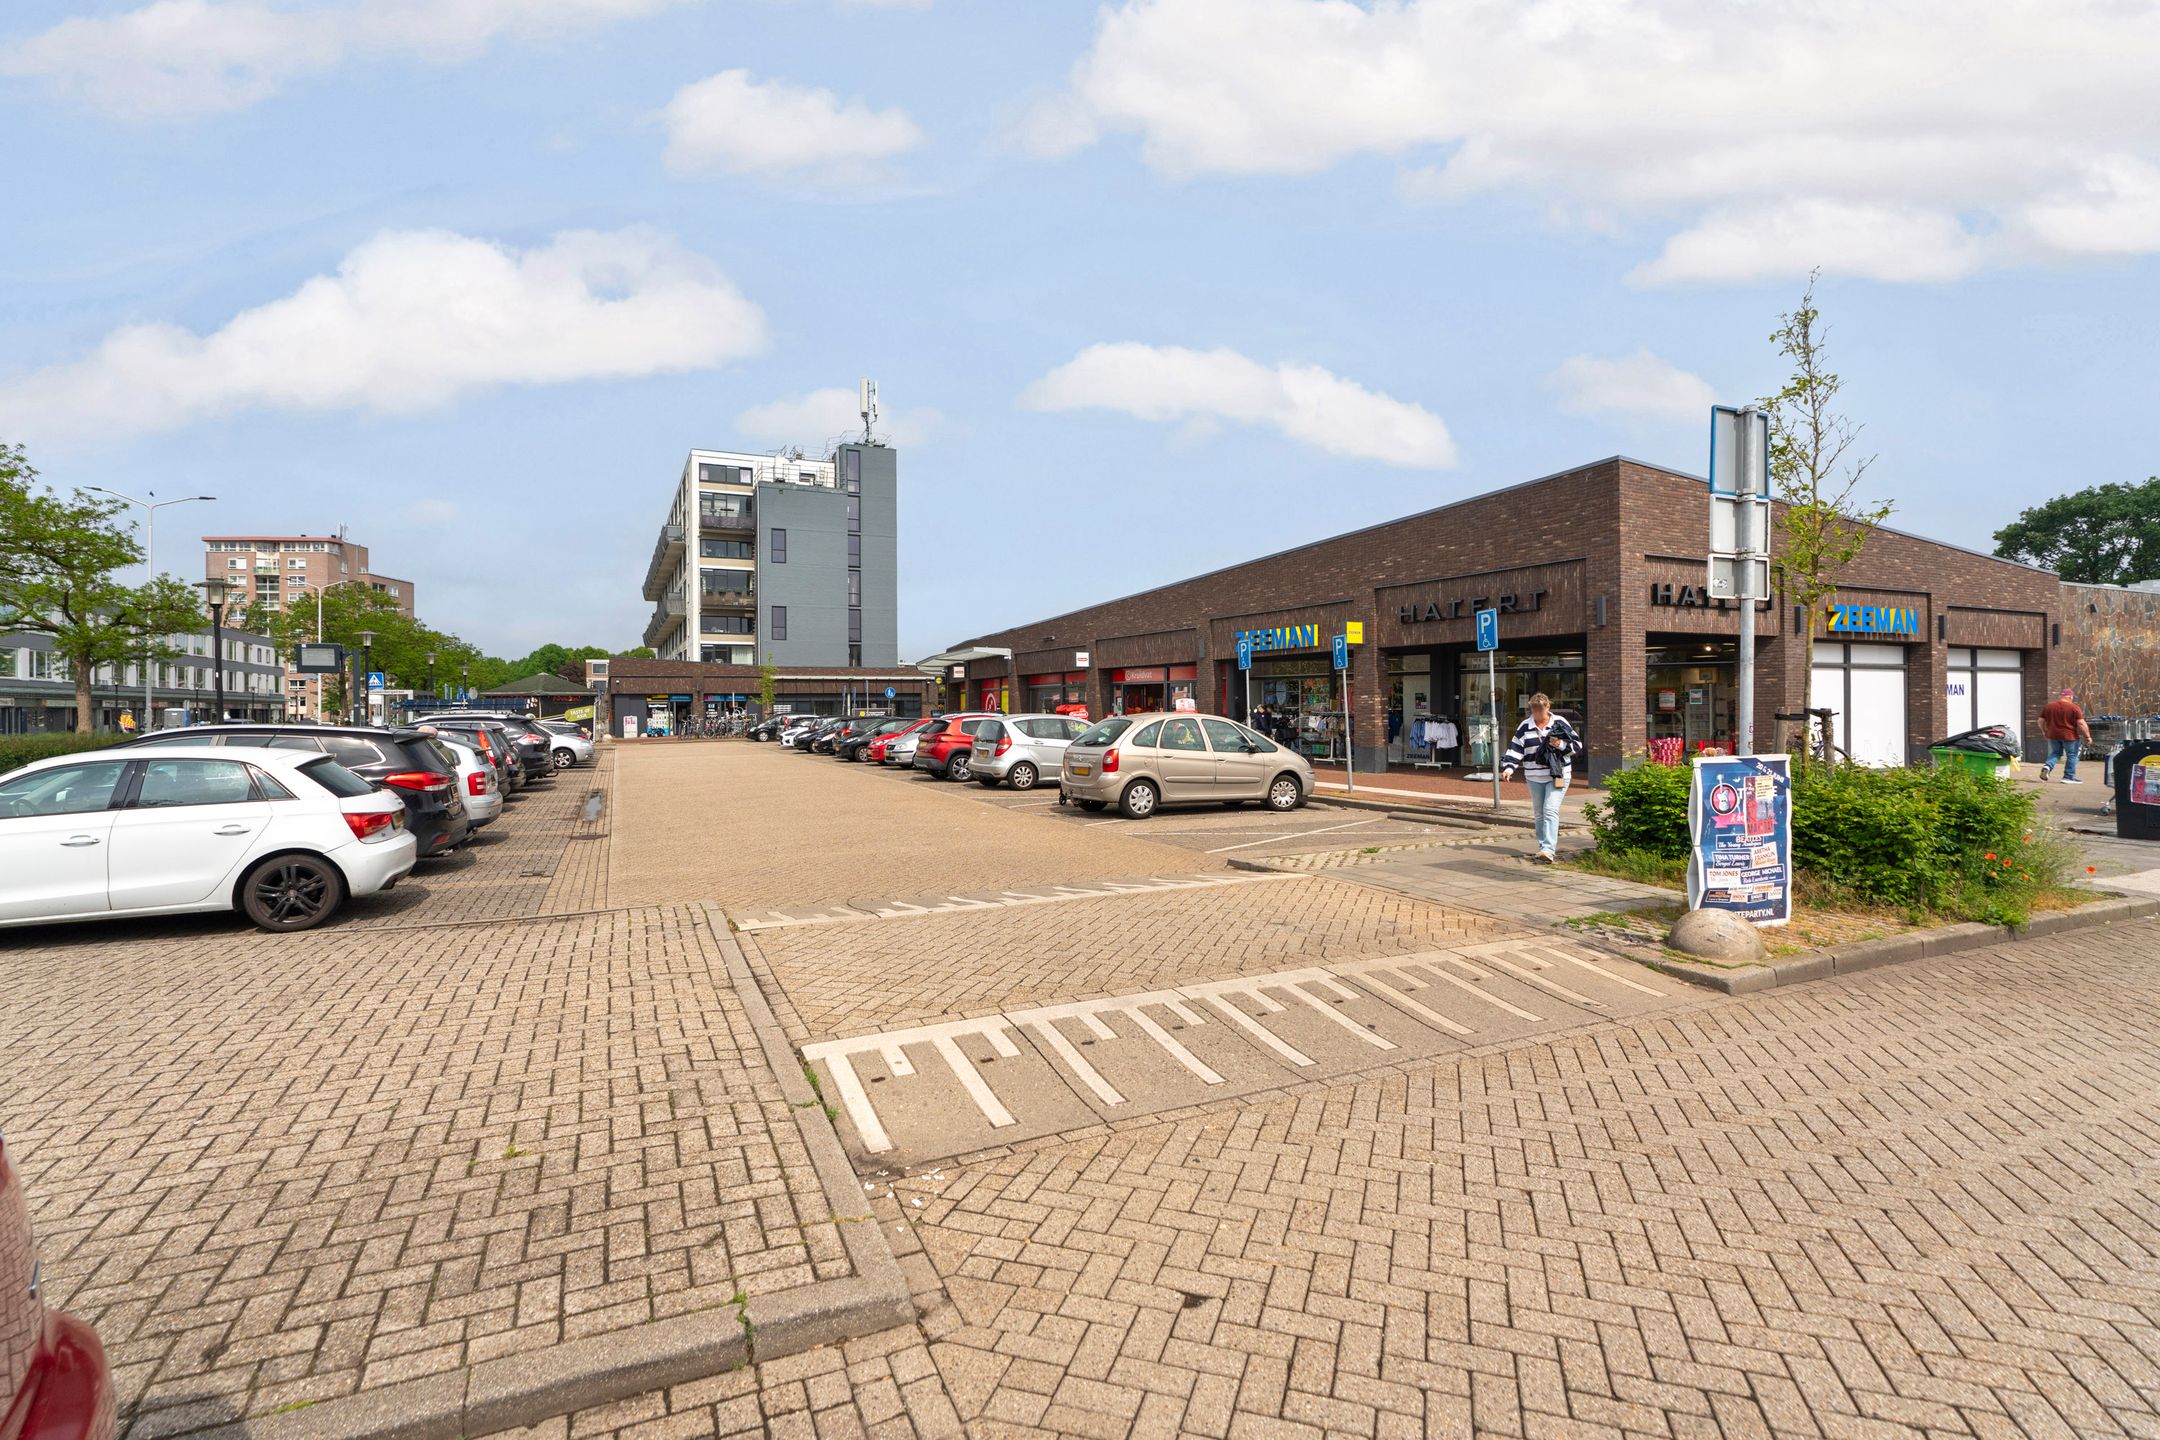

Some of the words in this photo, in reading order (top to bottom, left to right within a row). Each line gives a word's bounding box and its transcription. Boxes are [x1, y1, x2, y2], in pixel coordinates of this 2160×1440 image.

[1398, 589, 1547, 624] HATERT
[1481, 614, 1491, 634] P
[1829, 605, 1918, 635] ZEEMAN
[1240, 643, 1247, 657] P
[1335, 638, 1342, 655] P
[1946, 684, 1964, 695] MAN
[1735, 908, 1774, 918] TEPARTY.NL
